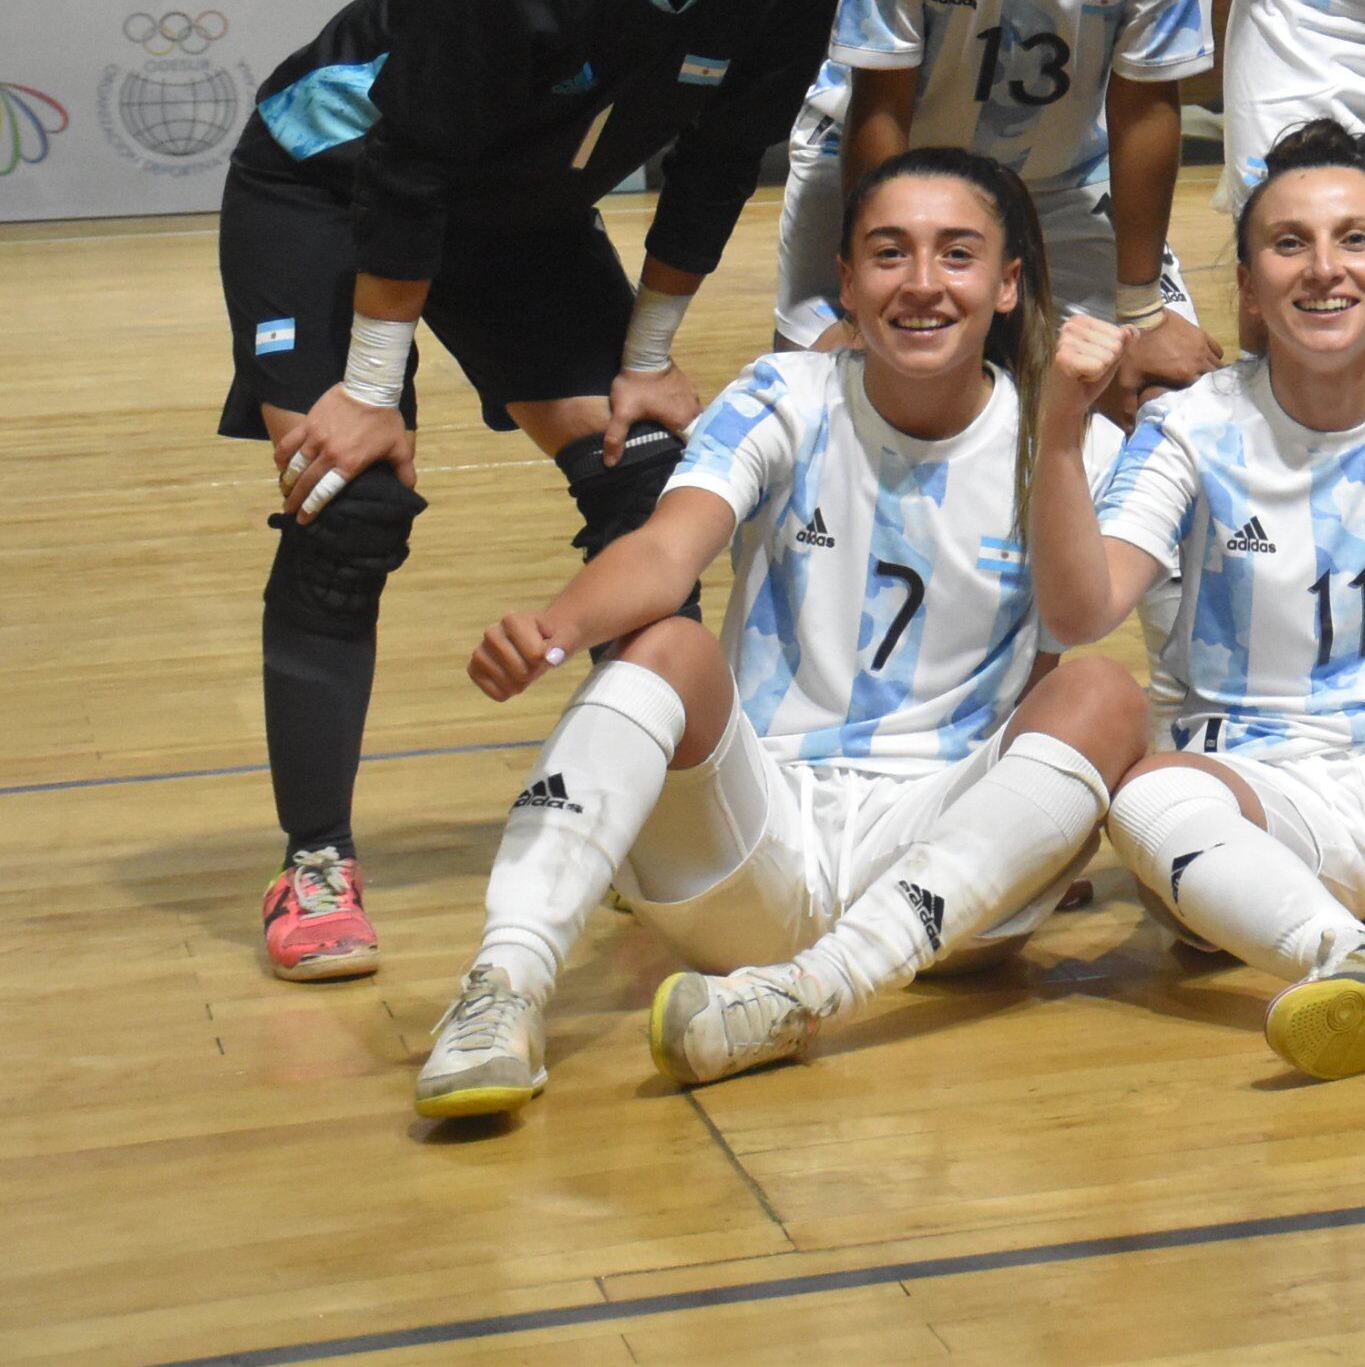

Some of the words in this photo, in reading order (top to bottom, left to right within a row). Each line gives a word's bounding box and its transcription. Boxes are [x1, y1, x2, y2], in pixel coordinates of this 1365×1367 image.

[974, 25, 1071, 107] 13
[571, 101, 616, 172] 1
[1226, 538, 1277, 554] adidas
[870, 560, 926, 672] 7
[899, 880, 941, 953] adidas
